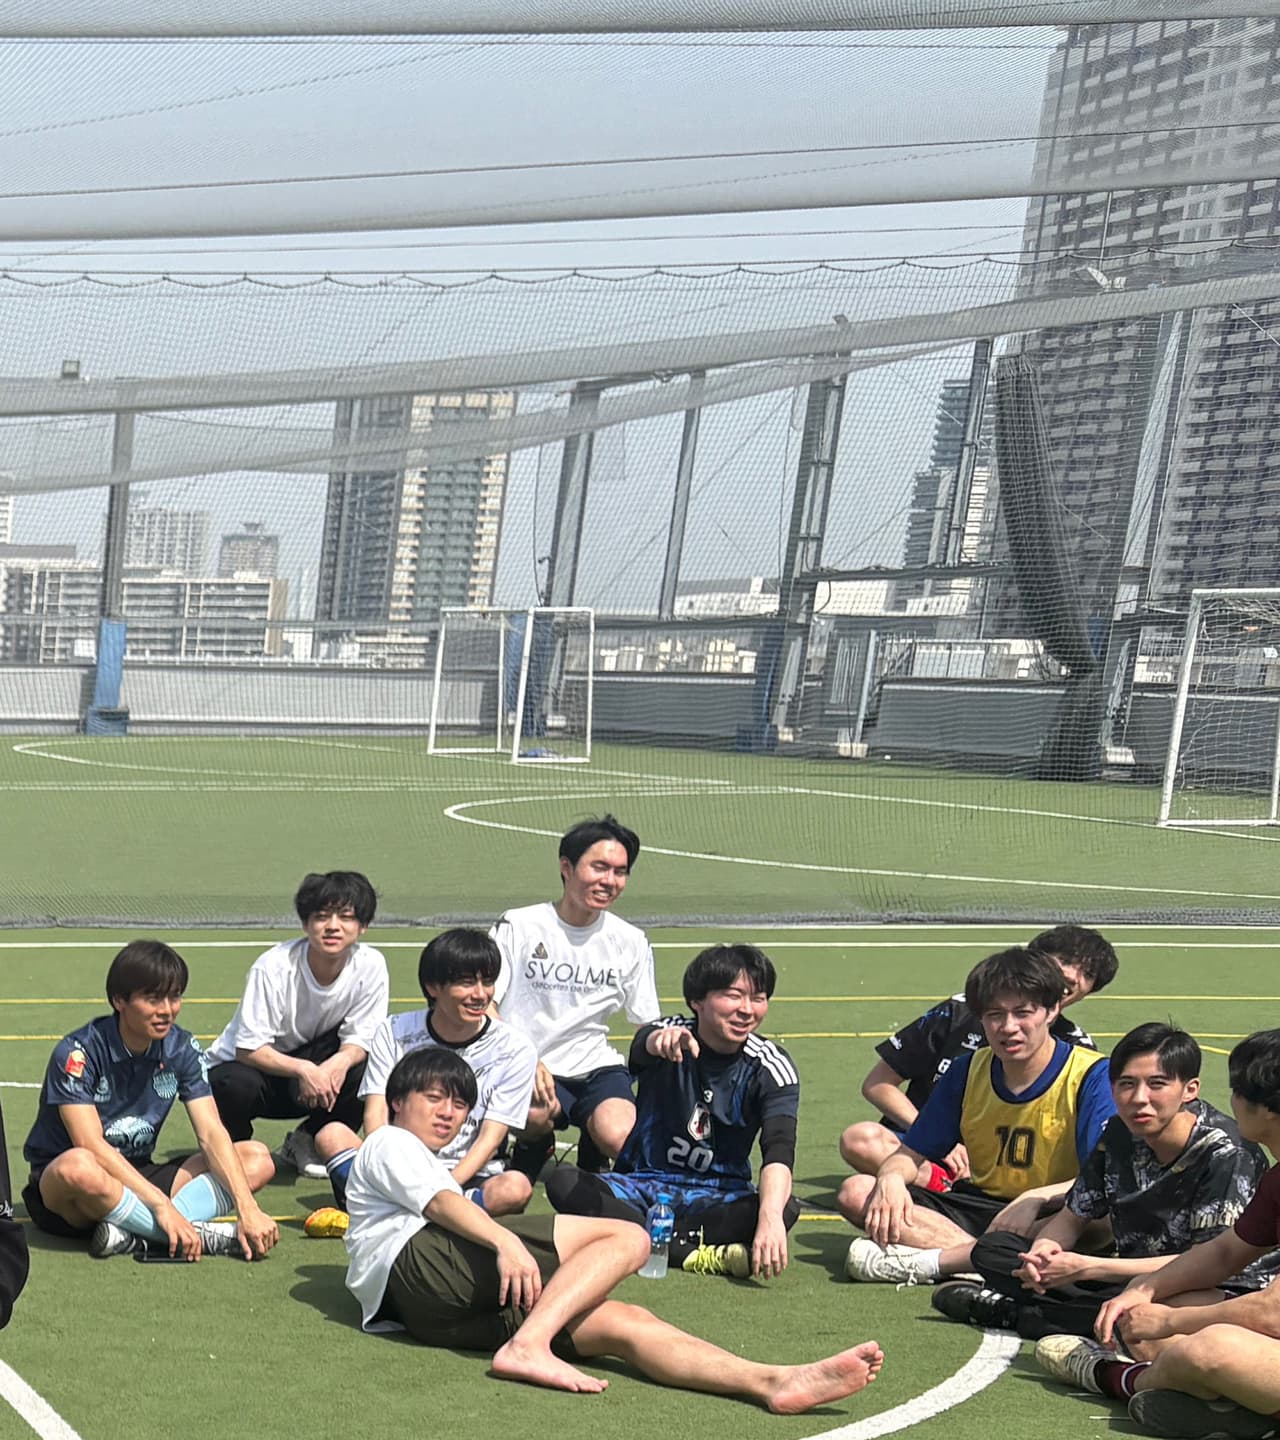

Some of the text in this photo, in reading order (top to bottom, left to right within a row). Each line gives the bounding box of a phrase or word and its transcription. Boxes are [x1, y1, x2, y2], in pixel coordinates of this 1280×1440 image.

[524, 961, 618, 987] SVOLME
[667, 1136, 715, 1173] 20
[994, 1125, 1036, 1169] 10
